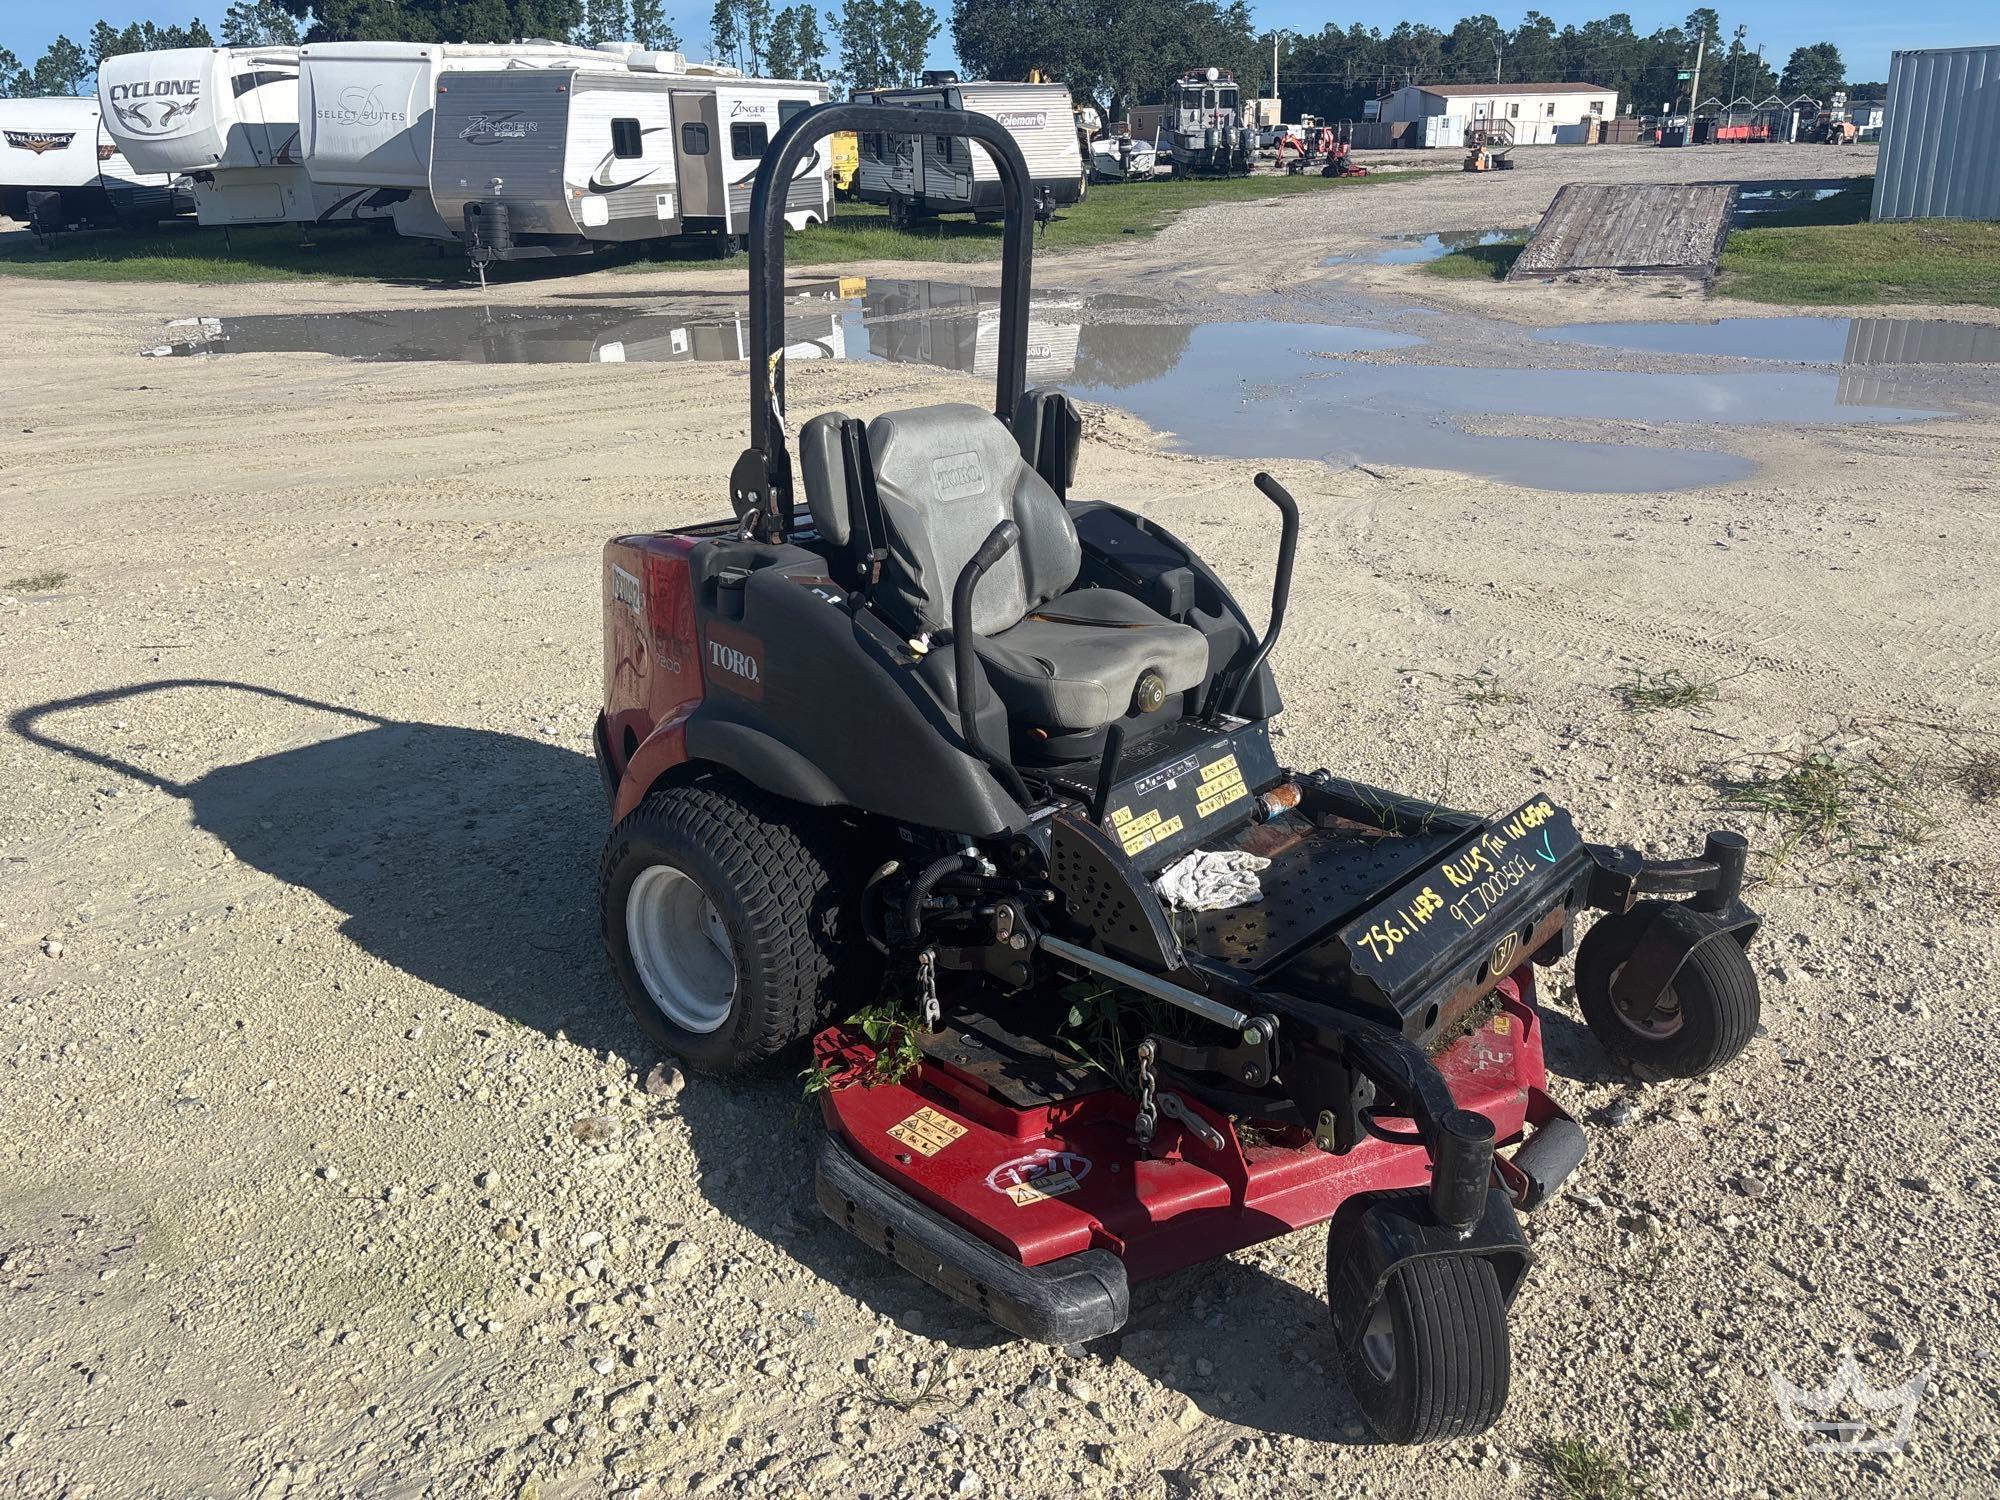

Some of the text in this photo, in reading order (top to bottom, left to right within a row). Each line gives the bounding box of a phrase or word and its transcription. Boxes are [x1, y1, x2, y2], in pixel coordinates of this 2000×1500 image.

[109, 79, 200, 101] CYCLONE
[317, 110, 405, 121] SELECT SUITES
[998, 113, 1036, 127] Coleman
[4, 133, 72, 143] WILDWOOD
[938, 464, 981, 489] TORO
[709, 640, 759, 682] TORO
[1357, 910, 1419, 962] 756.1
[1502, 816, 1527, 841] IN
